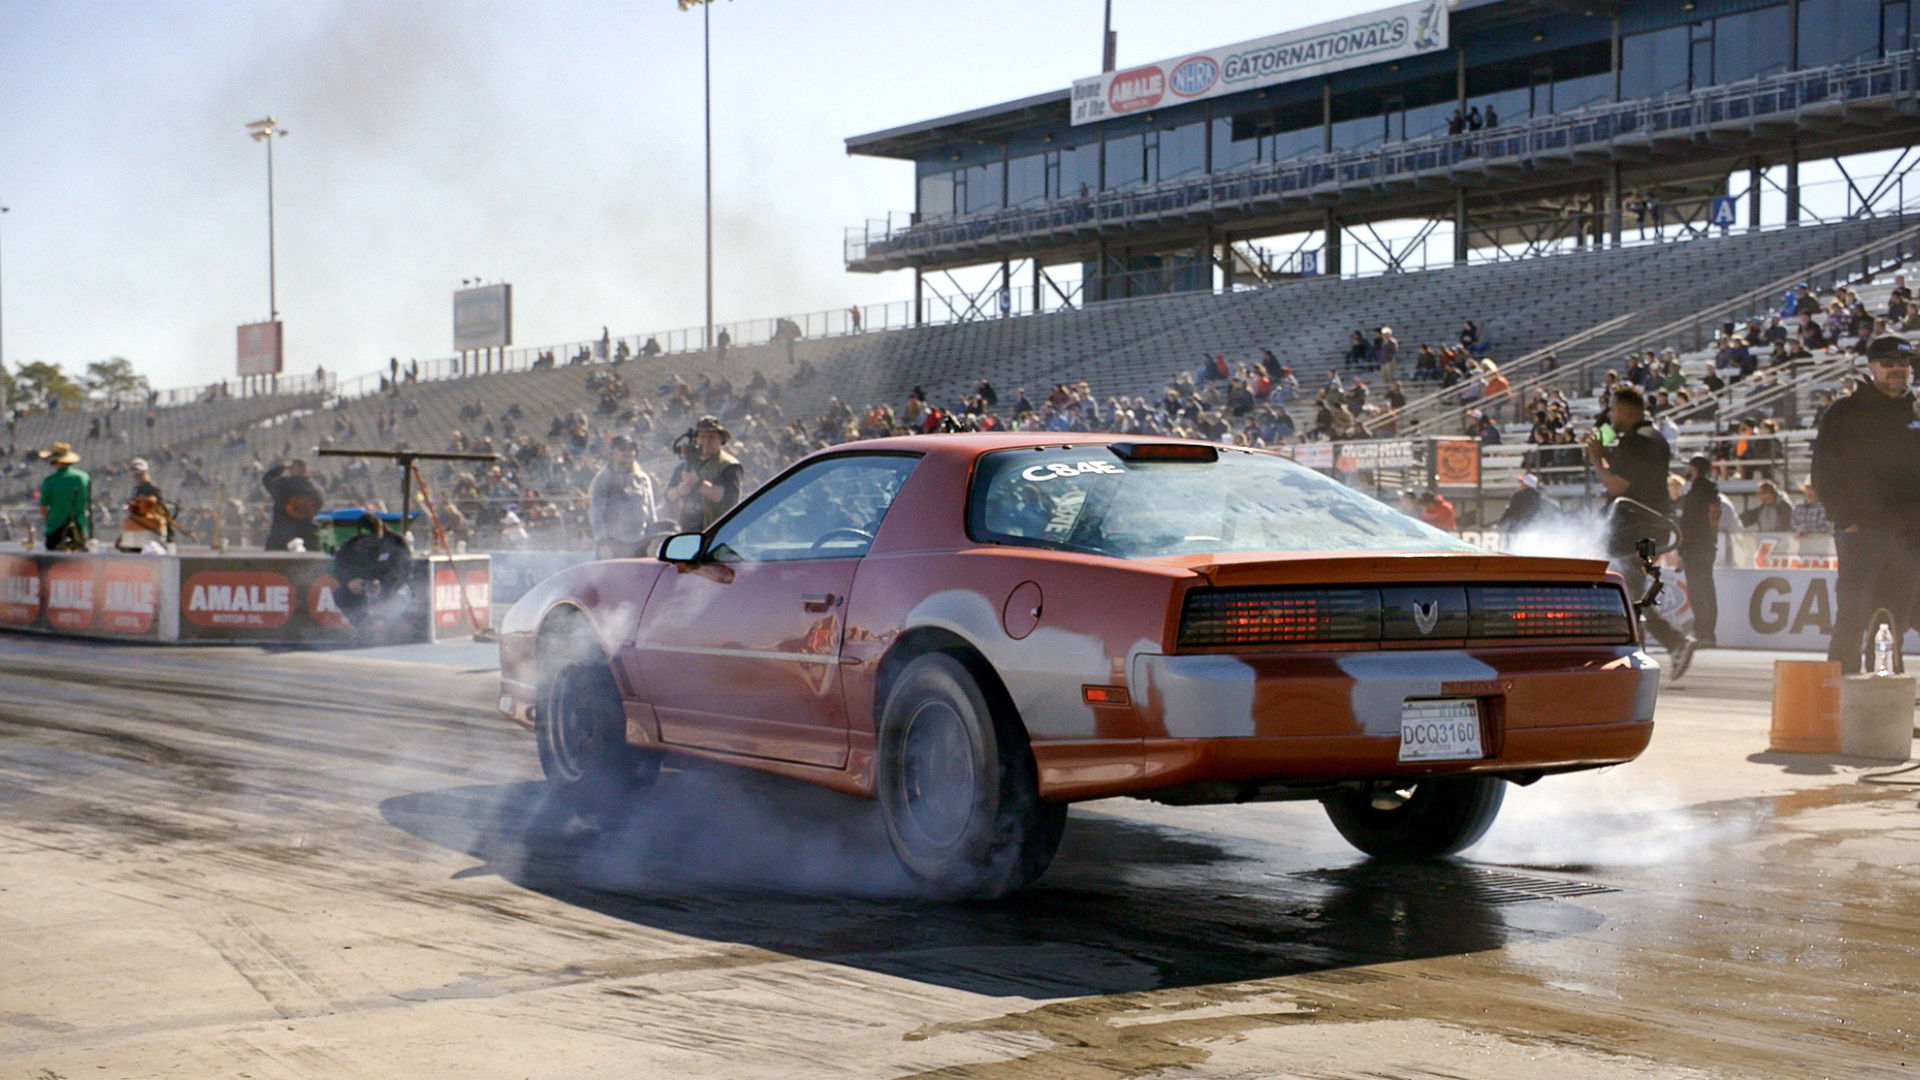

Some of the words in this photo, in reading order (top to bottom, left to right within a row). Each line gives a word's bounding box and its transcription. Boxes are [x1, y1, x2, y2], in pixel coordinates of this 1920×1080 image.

[1225, 23, 1405, 79] GATORNATIONALS
[1111, 74, 1162, 104] AMALIE
[1176, 62, 1213, 91] NHRA
[1714, 200, 1734, 223] A
[1022, 460, 1126, 482] C84E
[188, 585, 290, 613] AMALIE
[1403, 723, 1475, 745] DCQ3160
